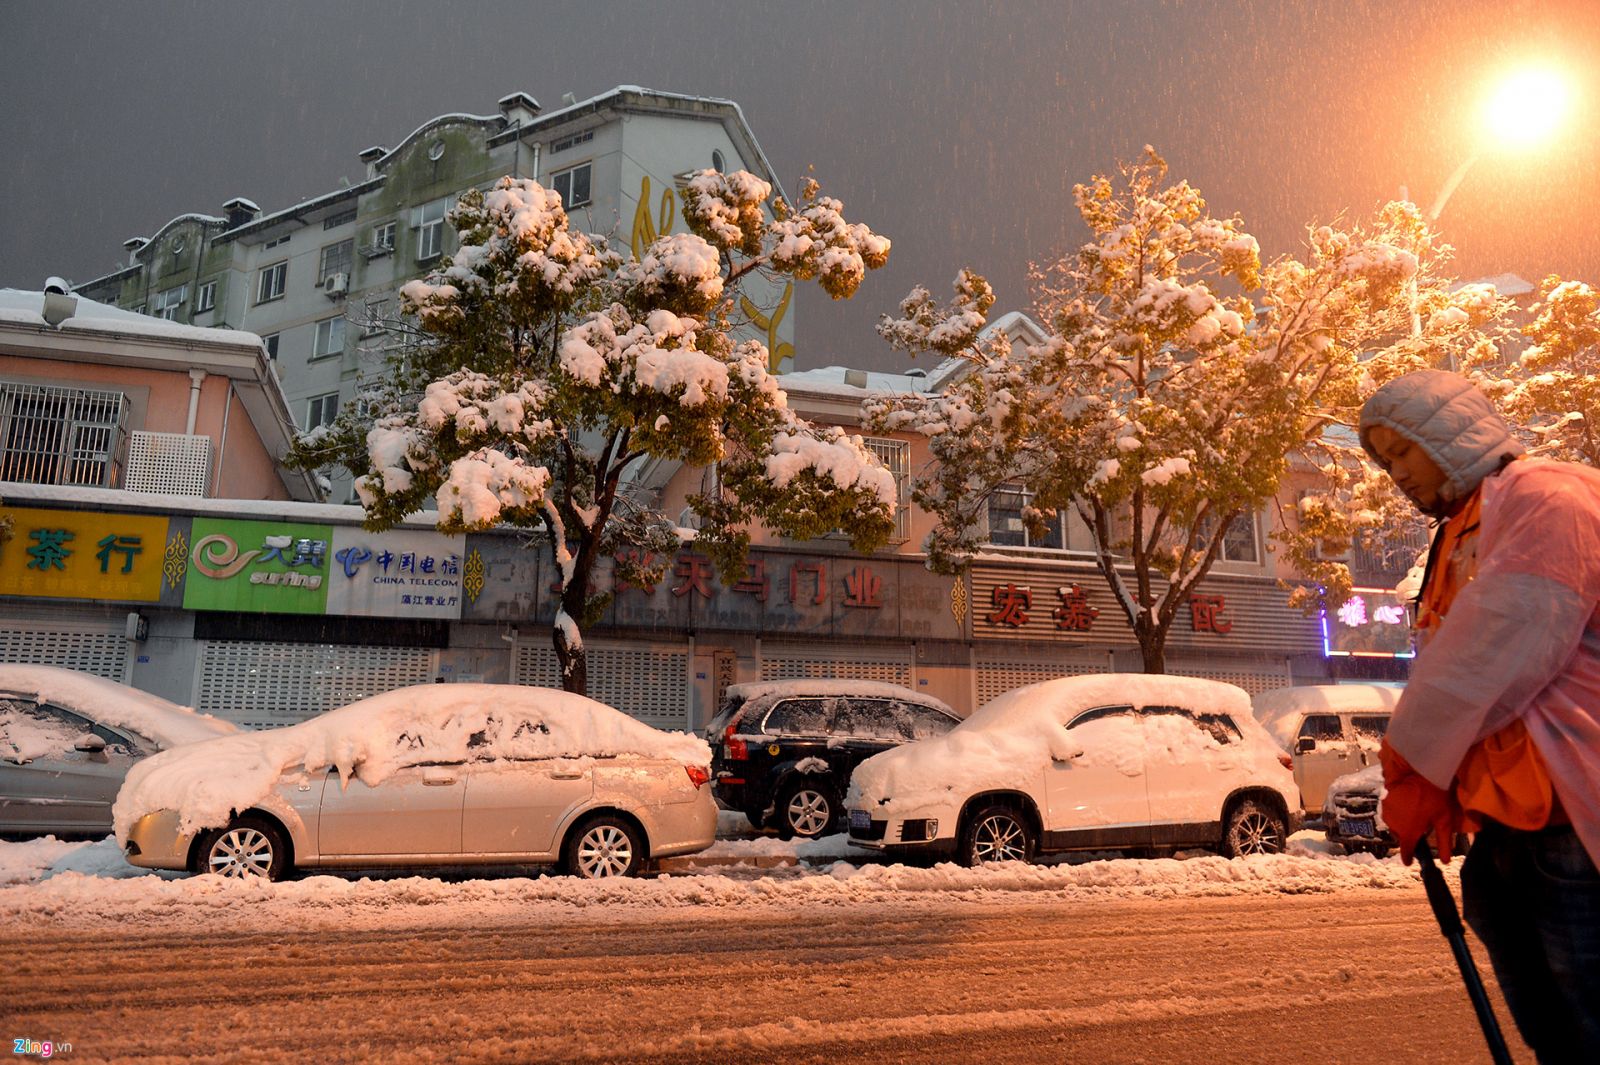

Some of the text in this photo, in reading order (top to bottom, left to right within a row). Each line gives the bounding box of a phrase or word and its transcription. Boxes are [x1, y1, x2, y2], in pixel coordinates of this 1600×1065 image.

[26, 529, 144, 573] 茶行
[256, 536, 328, 567] 天翼
[376, 550, 459, 574] 中国电信
[250, 571, 322, 590] surfing
[373, 576, 458, 587] CHINA TELECOM
[551, 547, 883, 607] 兴天马门业
[987, 583, 1232, 634] 宏嘉配
